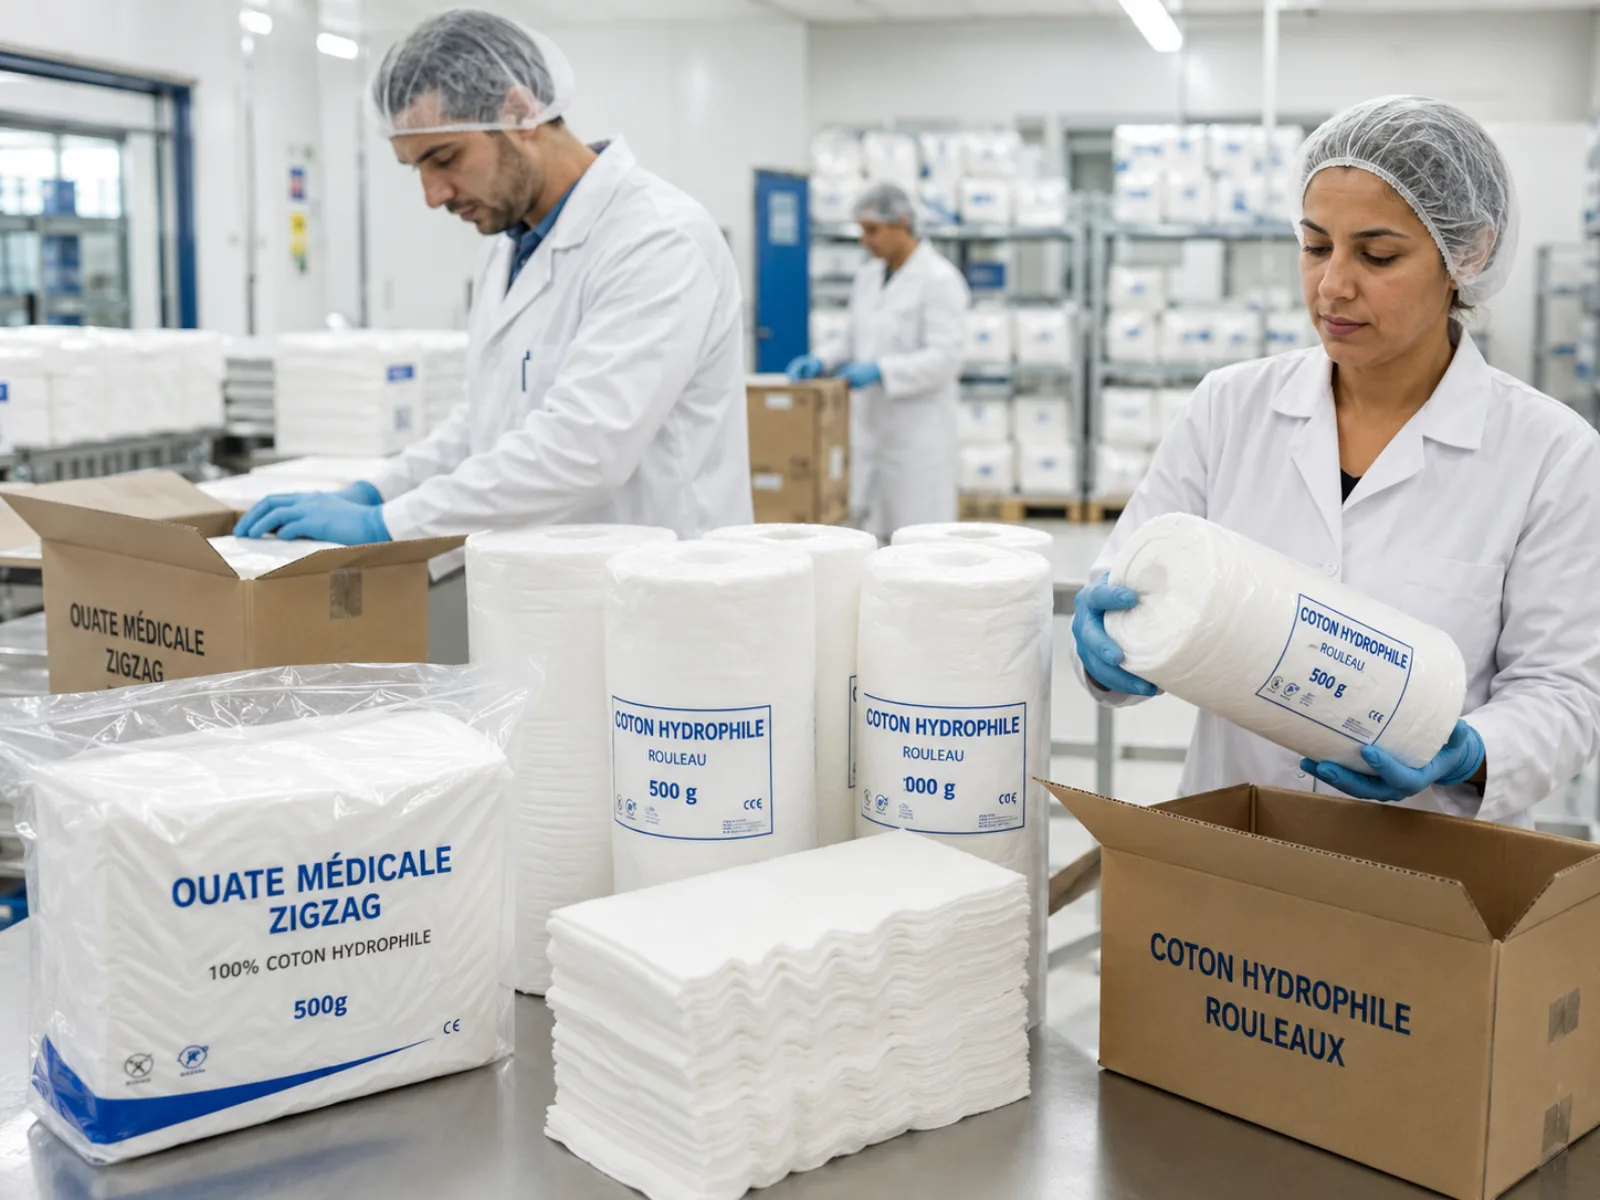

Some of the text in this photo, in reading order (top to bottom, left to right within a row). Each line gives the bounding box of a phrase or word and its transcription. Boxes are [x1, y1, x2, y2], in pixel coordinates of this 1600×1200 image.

[70, 602, 205, 656] OUATE MÉDICALE
[1300, 607, 1408, 669] COTON HYDROPHILE
[106, 648, 163, 683] ZIGZAG
[1320, 642, 1365, 671] ROULEAU
[1309, 668, 1347, 698] 500 g
[615, 710, 764, 740] COTON HYDROPHILE
[866, 708, 1020, 737] COTON HYDROPHILE
[649, 749, 707, 766] ROULEAU
[903, 746, 965, 762] ROULEAU
[650, 780, 697, 805] 500 g
[944, 782, 956, 800] g
[172, 846, 452, 908] OUATE MÉDICALE
[269, 893, 381, 934] ZIGZAG
[209, 929, 431, 980] 100% COTON HYDROPHILE
[1150, 932, 1411, 1036] COTON HYDROPHILE
[294, 995, 348, 1019] 500g
[1206, 996, 1345, 1067] ROULEAUX
